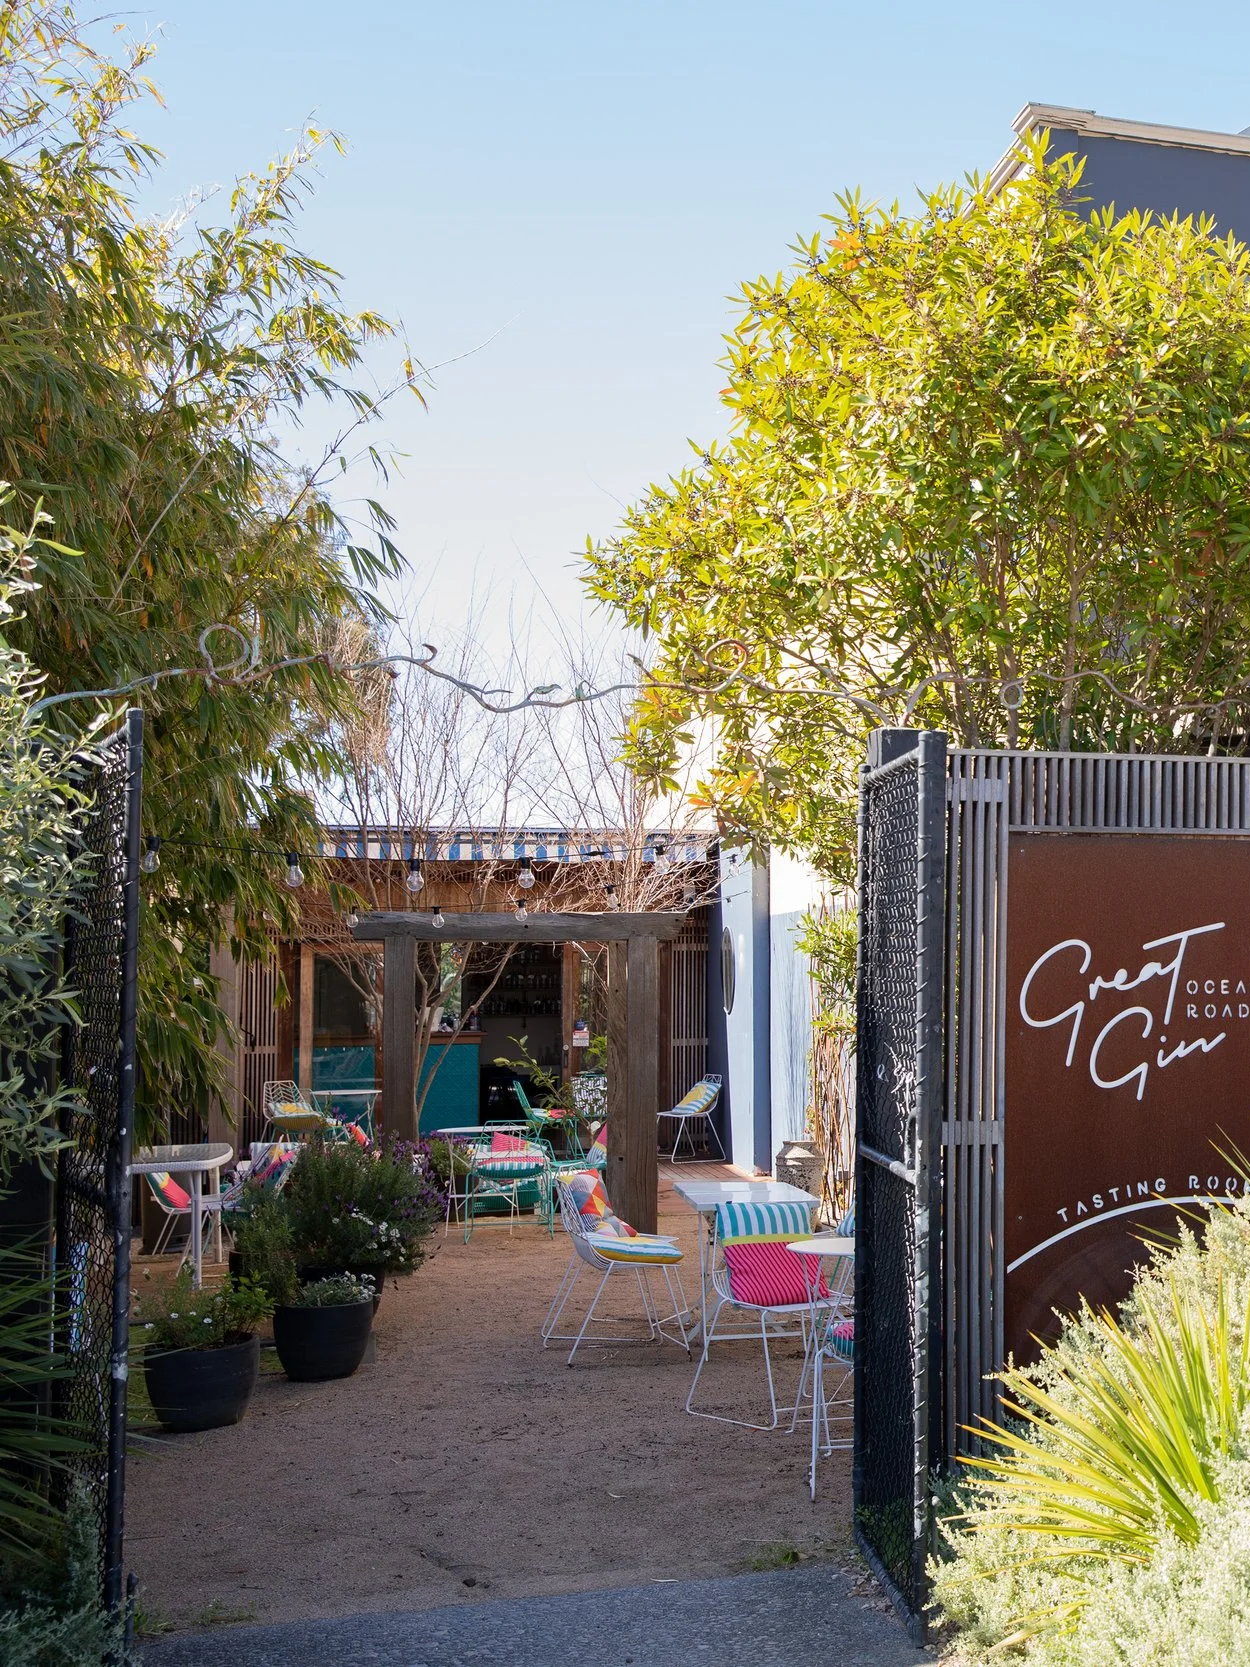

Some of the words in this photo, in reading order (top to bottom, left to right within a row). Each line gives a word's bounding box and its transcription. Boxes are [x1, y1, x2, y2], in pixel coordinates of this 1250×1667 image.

[1187, 1003, 1250, 1018] ROAD
[1090, 1006, 1226, 1101] Gin
[1057, 1177, 1167, 1223] TASTING
